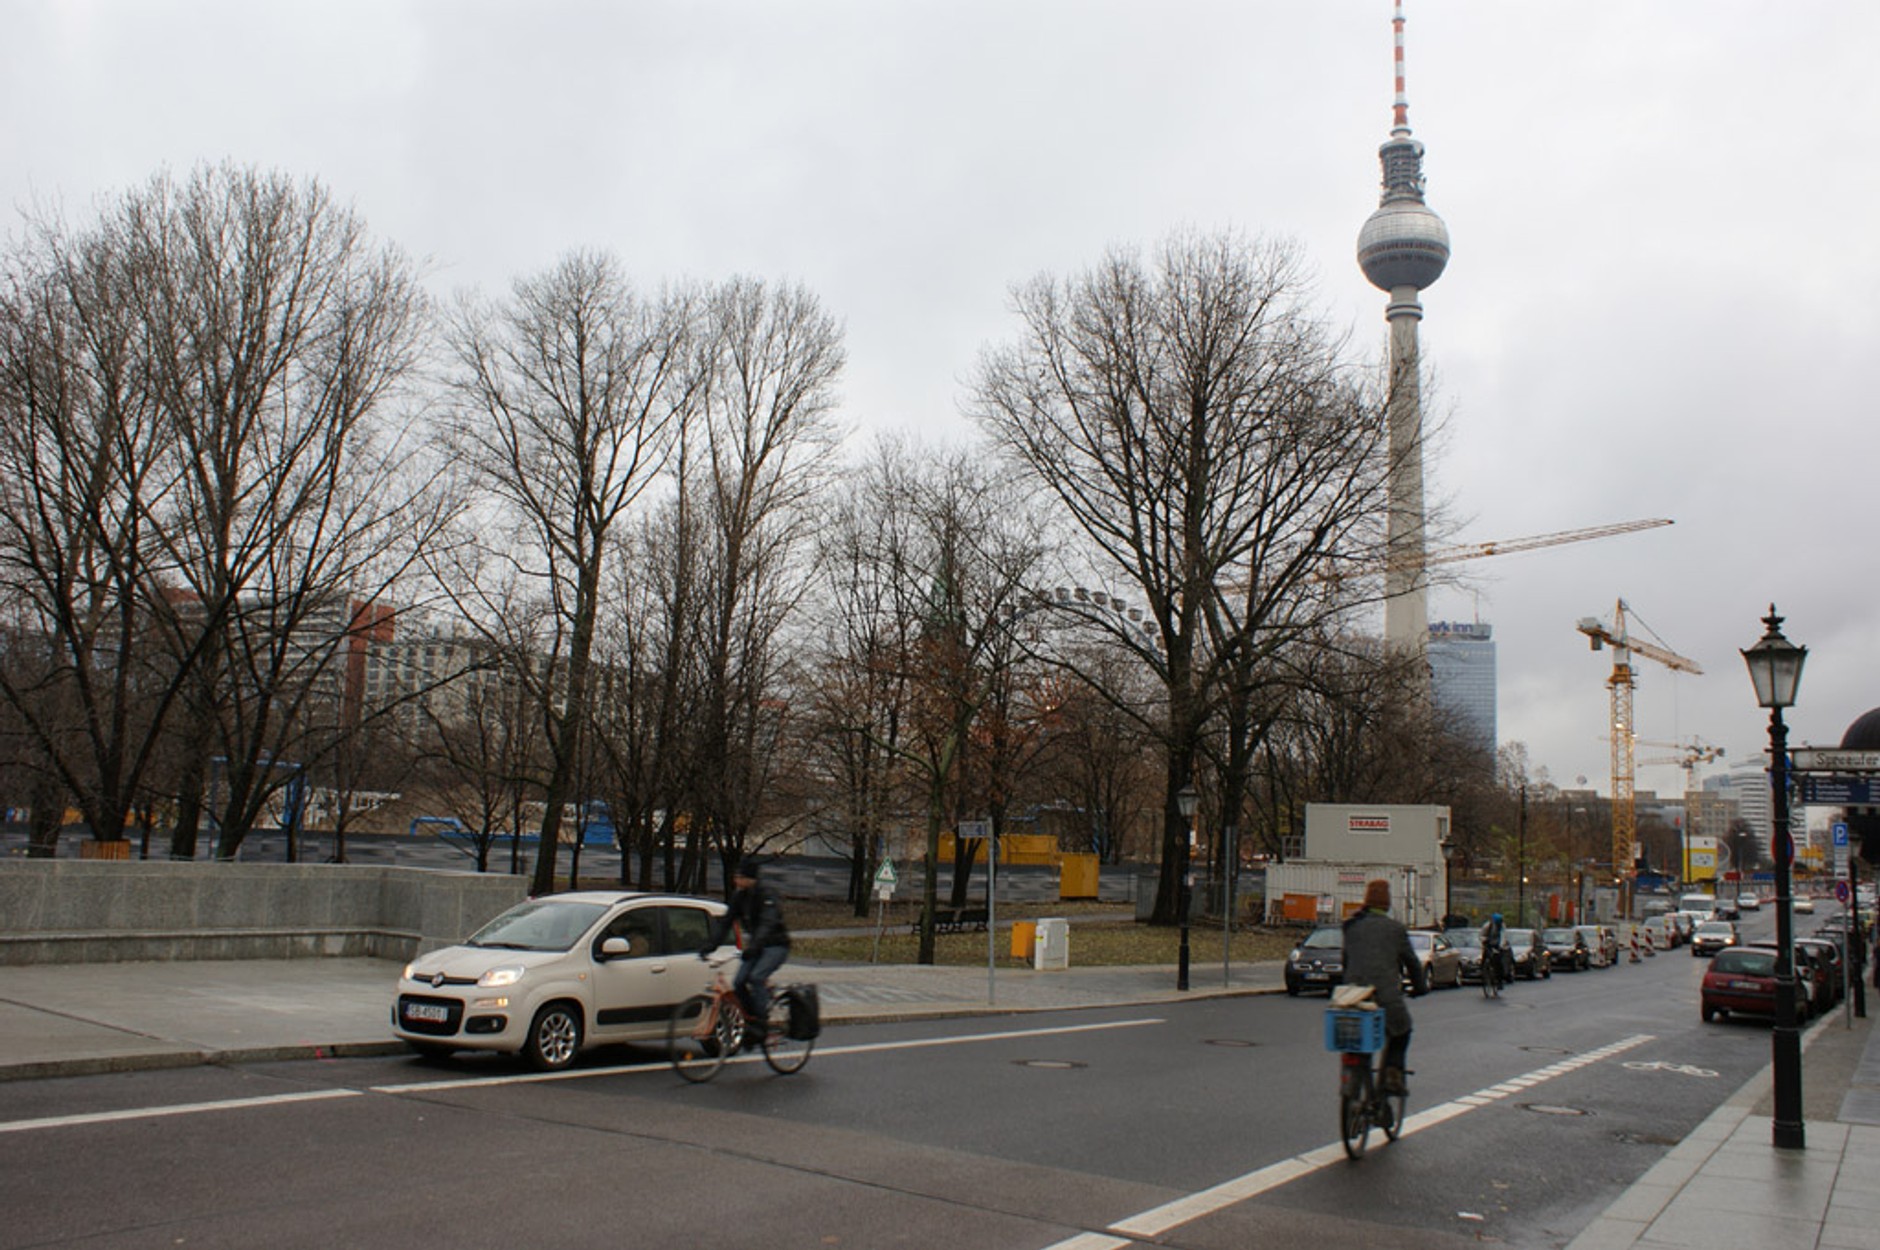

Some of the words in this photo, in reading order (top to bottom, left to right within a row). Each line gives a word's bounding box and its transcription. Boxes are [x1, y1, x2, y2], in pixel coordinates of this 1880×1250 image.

[1428, 620, 1450, 633] ark
[1452, 620, 1473, 633] inn
[1816, 752, 1879, 767] Spreeufer
[1836, 826, 1845, 844] P
